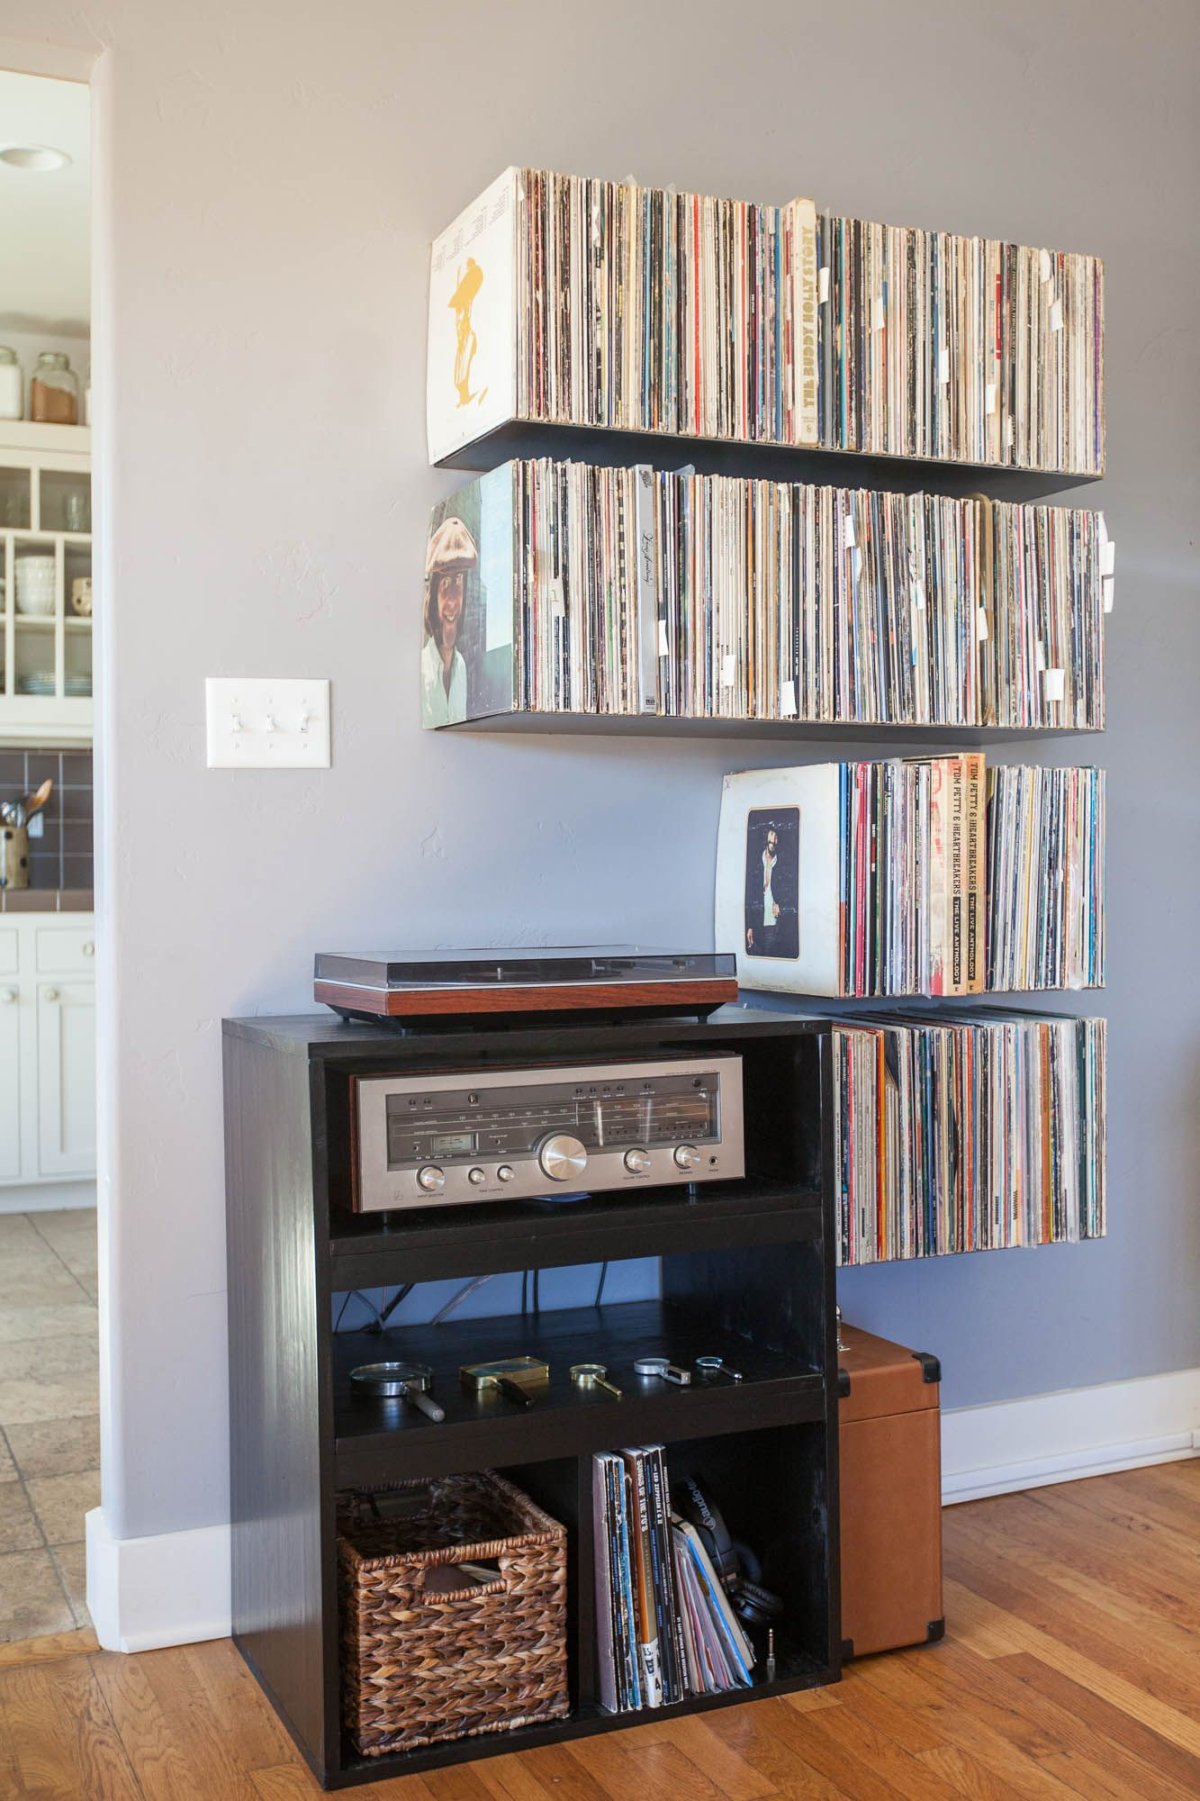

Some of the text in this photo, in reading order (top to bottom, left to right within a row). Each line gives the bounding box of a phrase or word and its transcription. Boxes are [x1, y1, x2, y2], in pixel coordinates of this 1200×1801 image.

[802, 224, 813, 277] STORY
[802, 277, 814, 323] HOLLY
[803, 326, 814, 377] BUDDY
[803, 379, 815, 408] THE
[953, 766, 962, 785] TOM
[970, 762, 979, 781] TOM
[953, 786, 962, 814] PETTY
[969, 782, 979, 809] PETTY
[968, 932, 976, 979] ANTHOLOGY
[638, 1487, 645, 1497] OF
